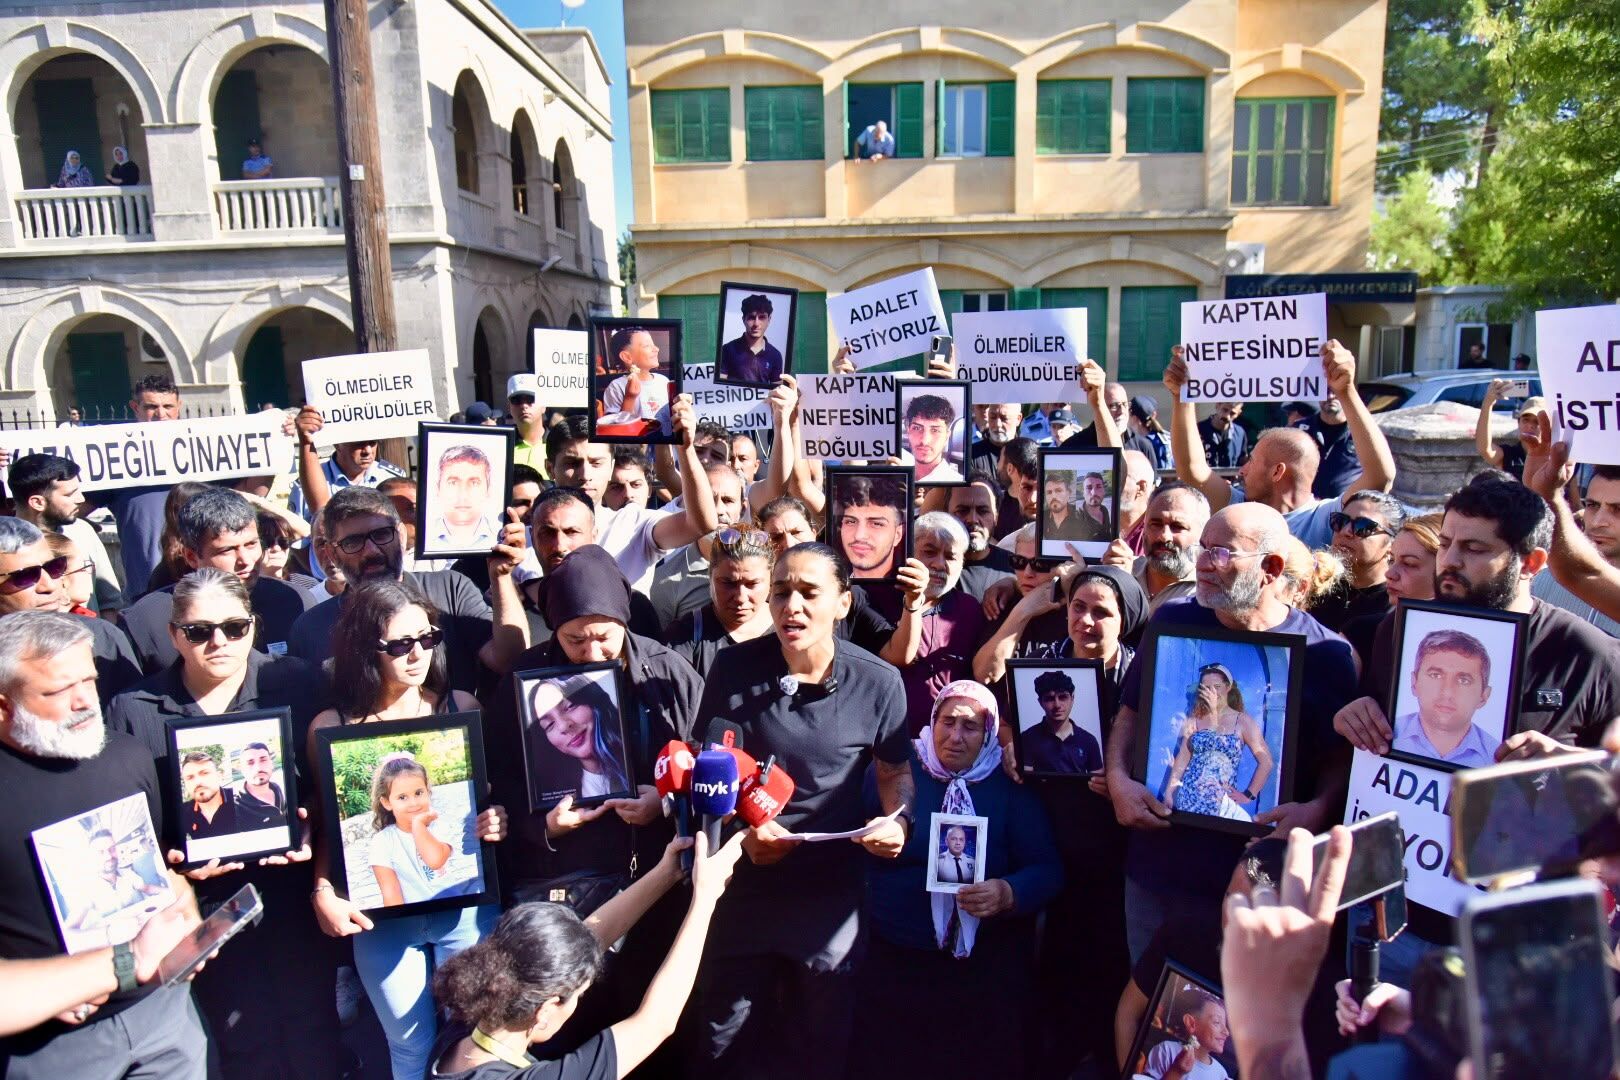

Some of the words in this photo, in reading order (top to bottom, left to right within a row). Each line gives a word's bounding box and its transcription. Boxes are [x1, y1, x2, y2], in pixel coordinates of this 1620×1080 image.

[850, 289, 918, 325] ADALET
[1202, 299, 1297, 325] KAPTAN
[843, 315, 940, 356] İSTİYORUZ
[974, 333, 1066, 354] ÖLMEDİLER
[551, 347, 588, 366] ÖLME
[1185, 334, 1320, 362] NEFESİNDE
[325, 373, 414, 397] ÖLMEDİLER
[683, 365, 715, 381] KAP
[815, 375, 895, 394] KAPTAN
[687, 385, 766, 406] FESİNDE
[1186, 372, 1320, 399] BOĞULSUN
[322, 399, 434, 424] LDÜRÜLDÜLER
[802, 403, 896, 426] NEFESİND
[86, 430, 167, 482] DEĞİL
[172, 427, 272, 475] CİNAYET
[805, 436, 896, 458] BOĞULSU
[694, 781, 729, 797] myk
[1371, 762, 1452, 817] ADAL
